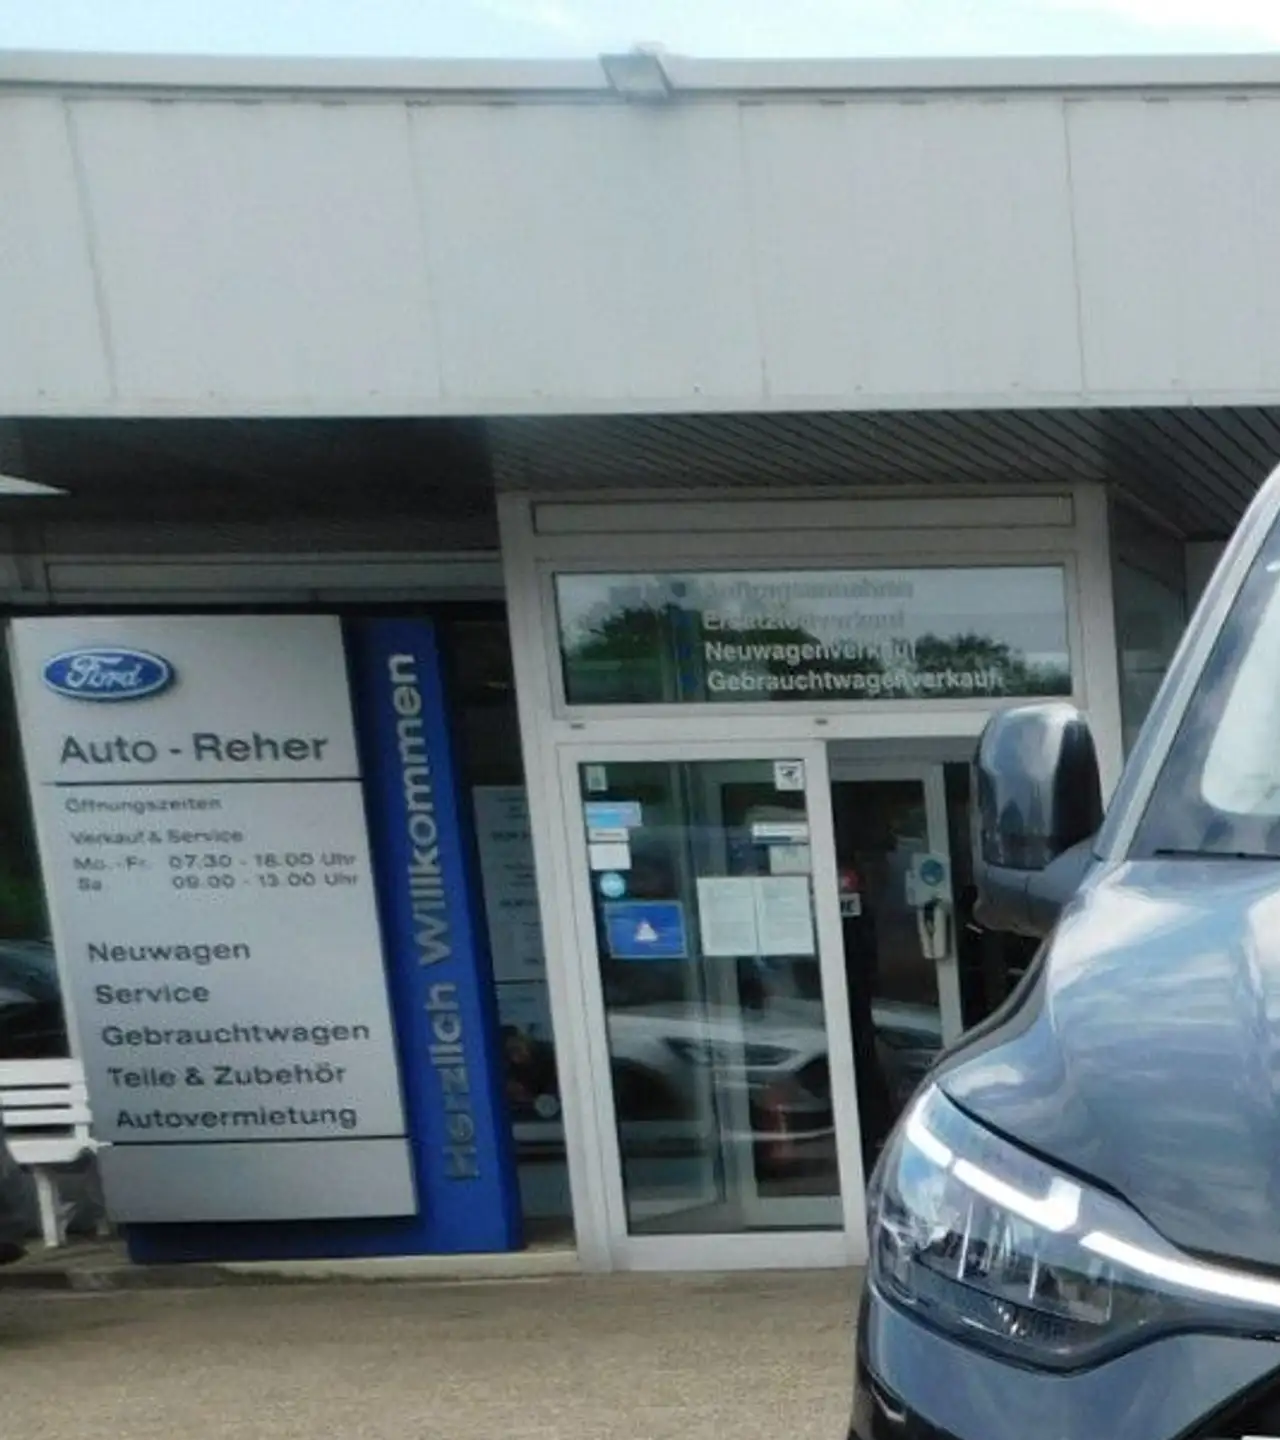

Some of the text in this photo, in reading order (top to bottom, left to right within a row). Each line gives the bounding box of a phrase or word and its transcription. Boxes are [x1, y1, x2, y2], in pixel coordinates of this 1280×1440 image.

[64, 655, 144, 690] Ford
[60, 734, 158, 765] Auto
[192, 731, 329, 763] Reher
[391, 652, 481, 1183] Herzlich Willkommen
[87, 942, 251, 965] Neuwagen
[95, 983, 210, 1004] Service
[101, 1023, 371, 1047] Gebrauchtwagen
[107, 1062, 347, 1088] Teile & Zubehör
[116, 1104, 358, 1130] Autovermietung
